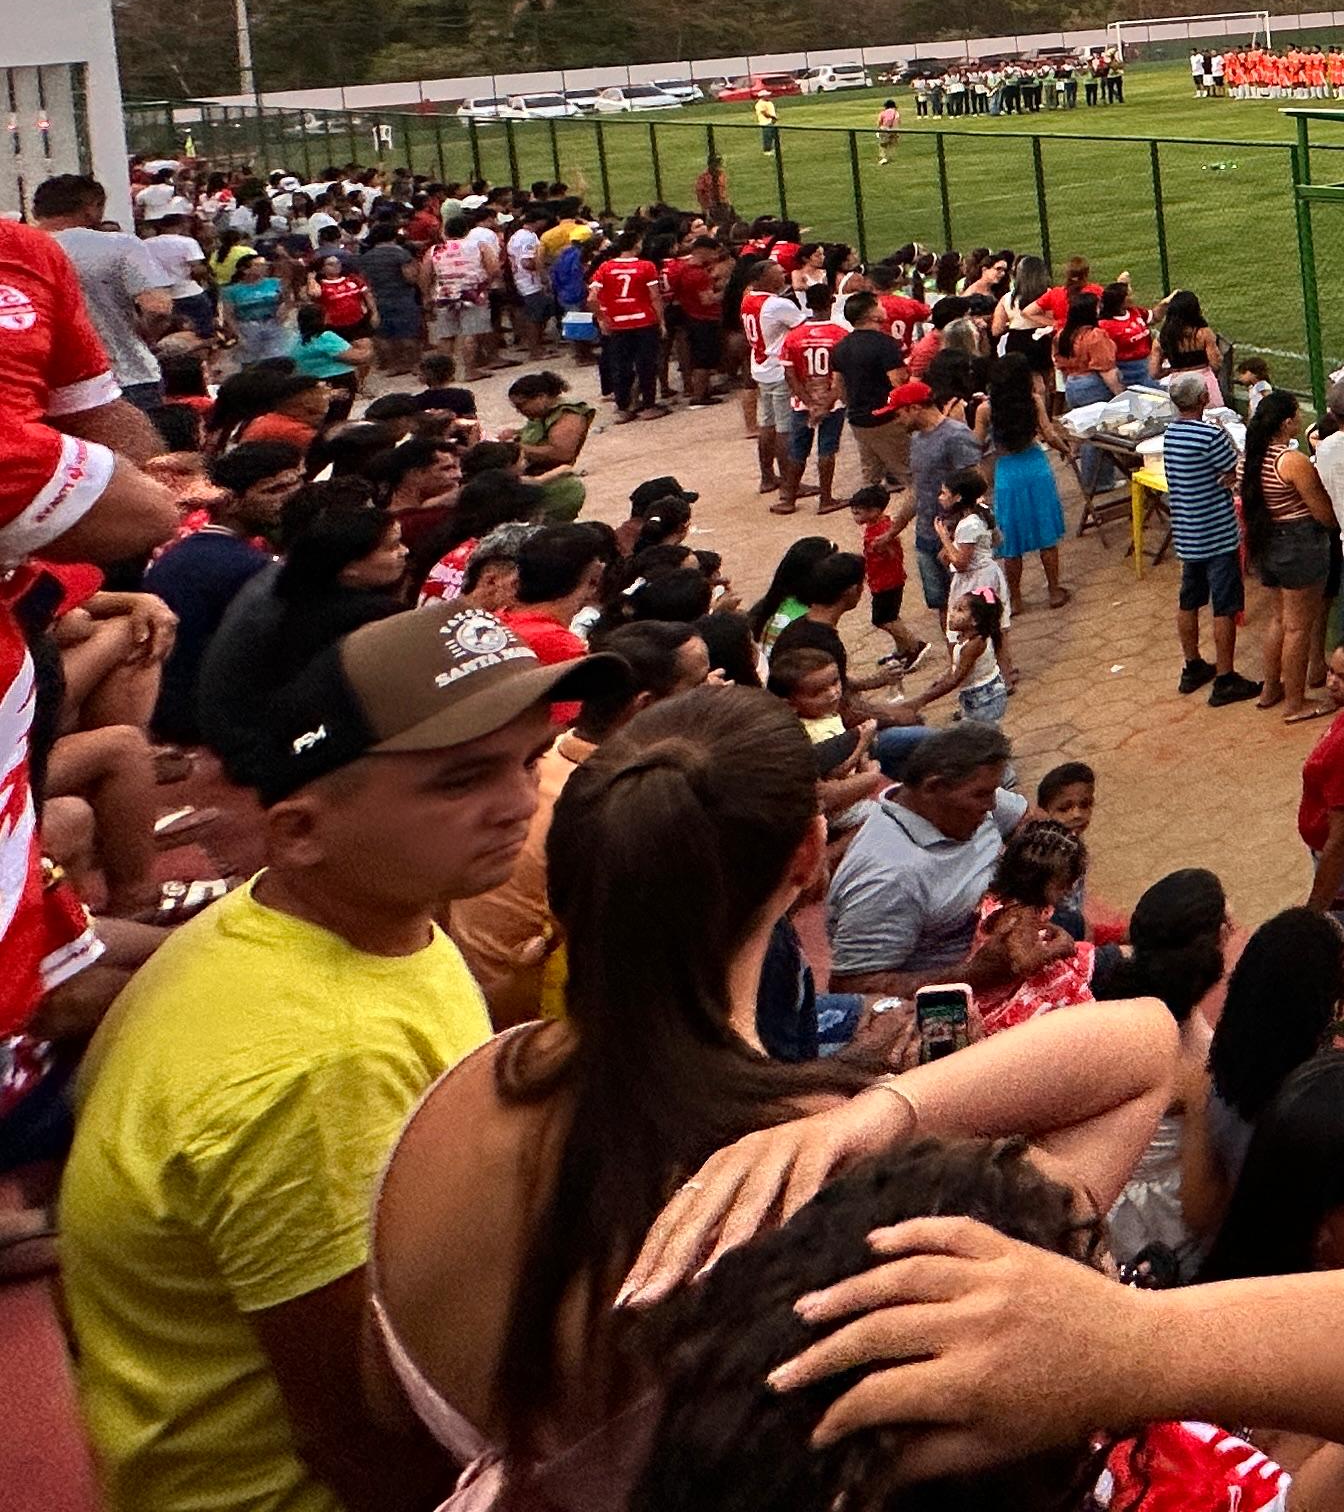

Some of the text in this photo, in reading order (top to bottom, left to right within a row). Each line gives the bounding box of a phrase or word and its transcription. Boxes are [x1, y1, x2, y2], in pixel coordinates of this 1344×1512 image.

[616, 274, 632, 298] 7
[742, 313, 759, 344] 10
[803, 347, 830, 376] 10
